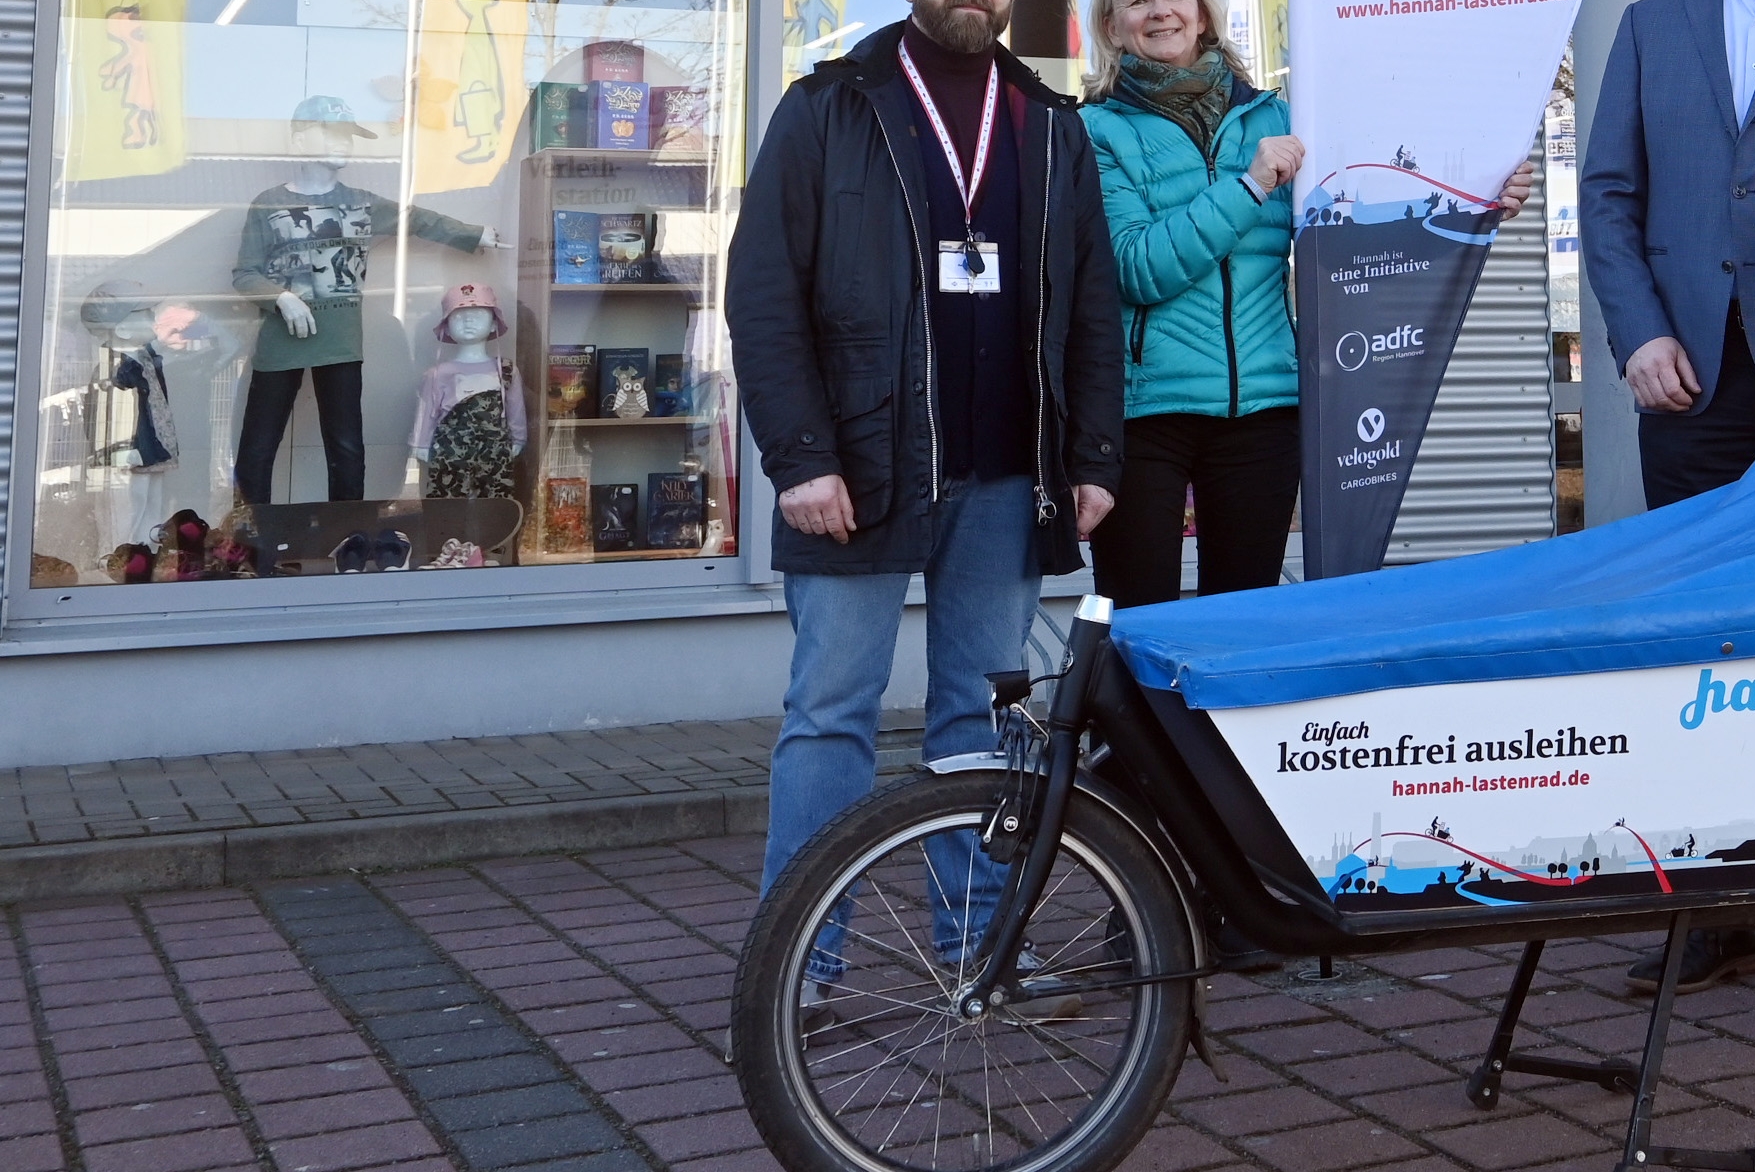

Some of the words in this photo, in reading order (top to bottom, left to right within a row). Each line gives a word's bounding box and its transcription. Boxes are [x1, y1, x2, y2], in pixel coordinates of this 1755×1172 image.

[1331, 267, 1361, 283] eine
[1364, 258, 1430, 278] Initiative
[1352, 251, 1389, 265] Hannah
[1392, 250, 1403, 260] ist
[1343, 282, 1370, 297] von
[1372, 325, 1424, 352] adfc
[1337, 440, 1401, 470] velogold
[1340, 472, 1397, 491] CARGOBIKES
[1301, 720, 1370, 746] Einfach
[1277, 735, 1457, 774] kostenfrei
[1465, 727, 1630, 763] ausleihen
[1391, 770, 1590, 797] hannah-lastenrad.de
